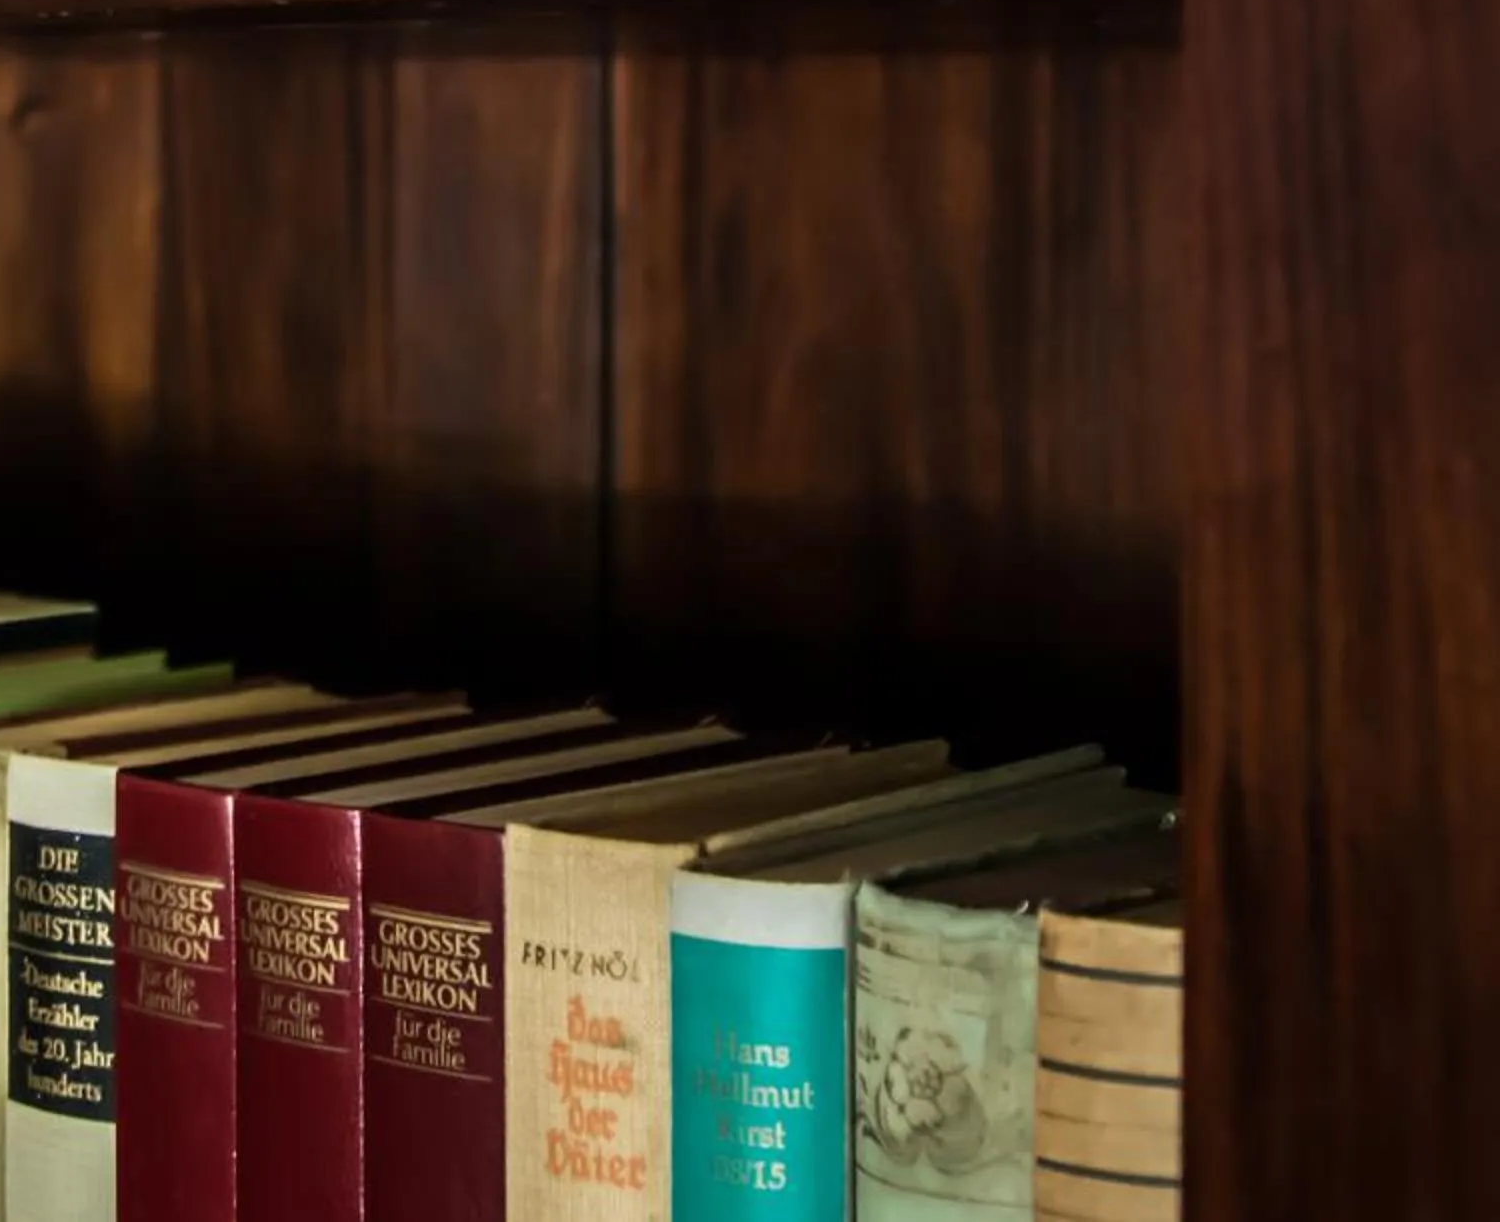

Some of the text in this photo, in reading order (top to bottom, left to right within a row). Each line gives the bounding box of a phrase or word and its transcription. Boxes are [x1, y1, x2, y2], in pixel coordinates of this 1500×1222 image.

[38, 845, 79, 874] DIE
[14, 876, 116, 916] GROSSEN
[128, 875, 214, 914] GROSSES
[19, 910, 115, 948] MEISTER
[121, 897, 225, 941] UNIVERSAL
[247, 895, 339, 935] GROSSES
[131, 924, 210, 964] LEXIKON
[241, 919, 351, 963] UNIVERSAL
[379, 919, 482, 960] GROSSES
[521, 940, 584, 976] FRITZ
[24, 961, 104, 998] Deutsche
[249, 946, 336, 986] LEXIKON
[371, 943, 493, 989] UNIVERSAL
[382, 972, 478, 1013] LEXIKON
[28, 997, 100, 1031] Erzähler
[427, 1018, 462, 1047] die
[43, 1037, 69, 1062] 20.
[713, 1024, 791, 1069] Hans
[28, 1067, 102, 1103] hunderts
